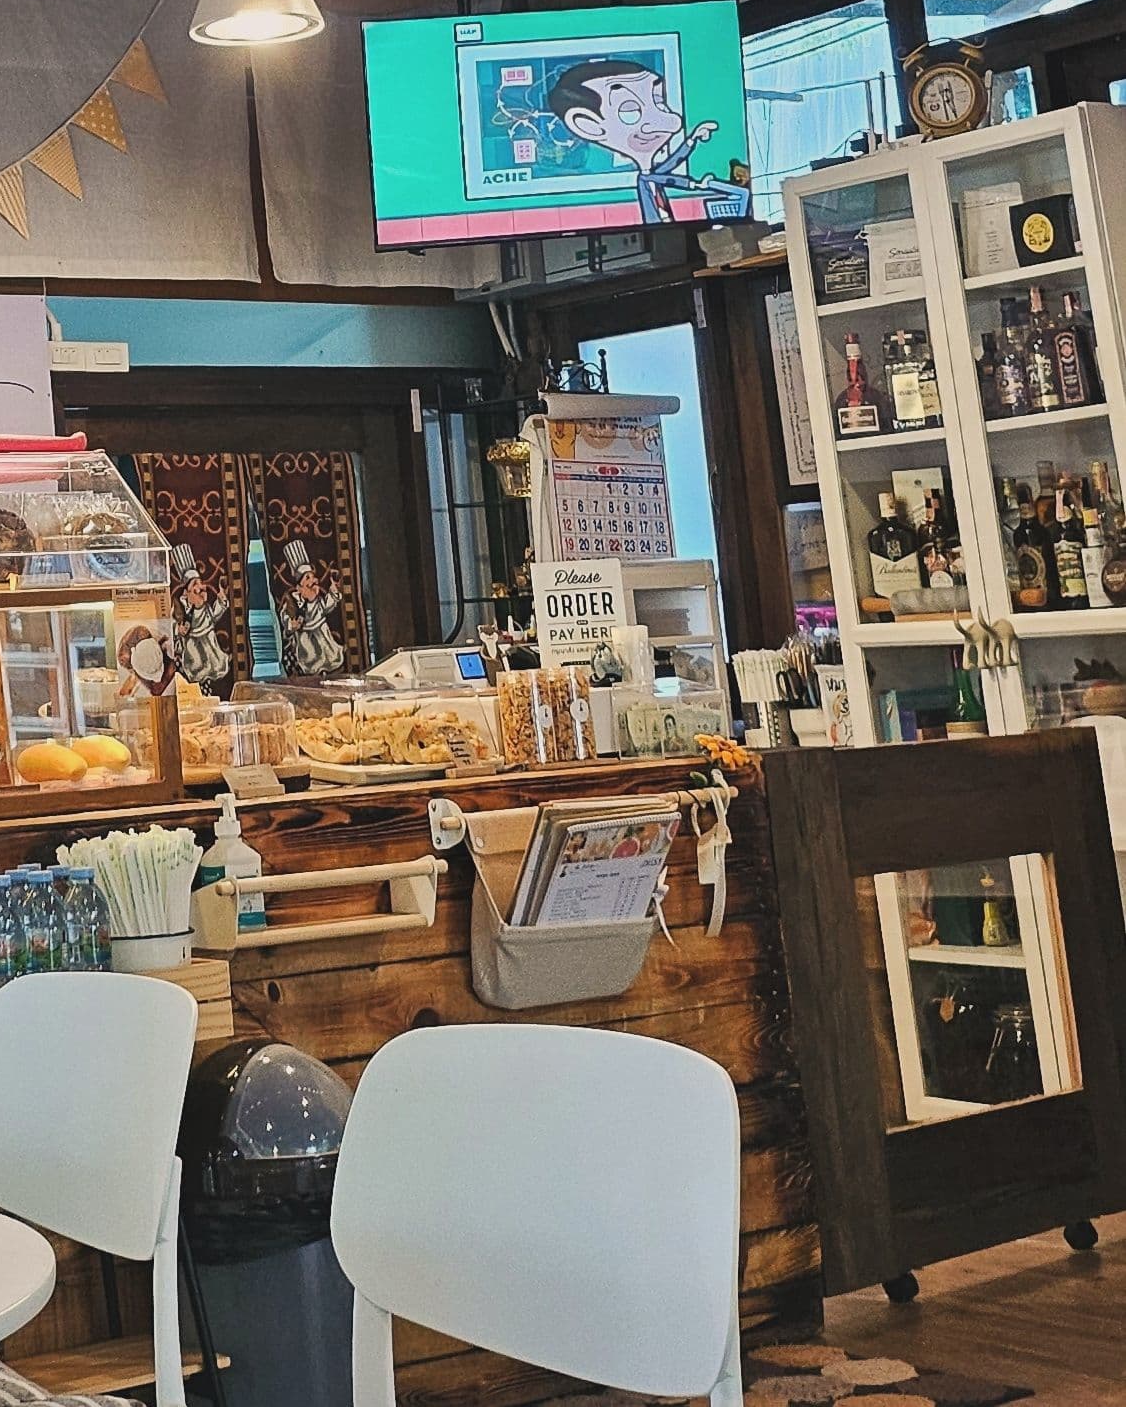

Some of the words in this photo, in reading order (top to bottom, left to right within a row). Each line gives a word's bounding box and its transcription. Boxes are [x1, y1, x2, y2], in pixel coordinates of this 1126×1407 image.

[607, 483, 612, 494] 1
[622, 483, 629, 495] 2
[638, 483, 644, 496] 3
[652, 484, 659, 496] 4
[562, 499, 569, 512] 5
[577, 499, 584, 512] 6
[593, 500, 599, 512] 7
[608, 501, 614, 513] 8
[624, 501, 630, 514] 9
[638, 502, 648, 514] 10
[654, 502, 662, 515] 11
[562, 518, 572, 531] 12
[577, 518, 587, 532] 13
[592, 519, 603, 532] 14
[608, 520, 618, 532] 15
[623, 520, 634, 533] 16
[639, 520, 648, 533] 17
[654, 521, 665, 534] 18
[564, 538, 574, 550] 19
[578, 538, 590, 551] 20
[594, 539, 604, 551] 21
[609, 539, 620, 551] 22
[624, 539, 636, 552] 23
[639, 540, 651, 552] 24
[655, 541, 668, 553] 25
[554, 569, 602, 586] Please
[546, 592, 615, 618] ORDER
[549, 628, 575, 641] PAY
